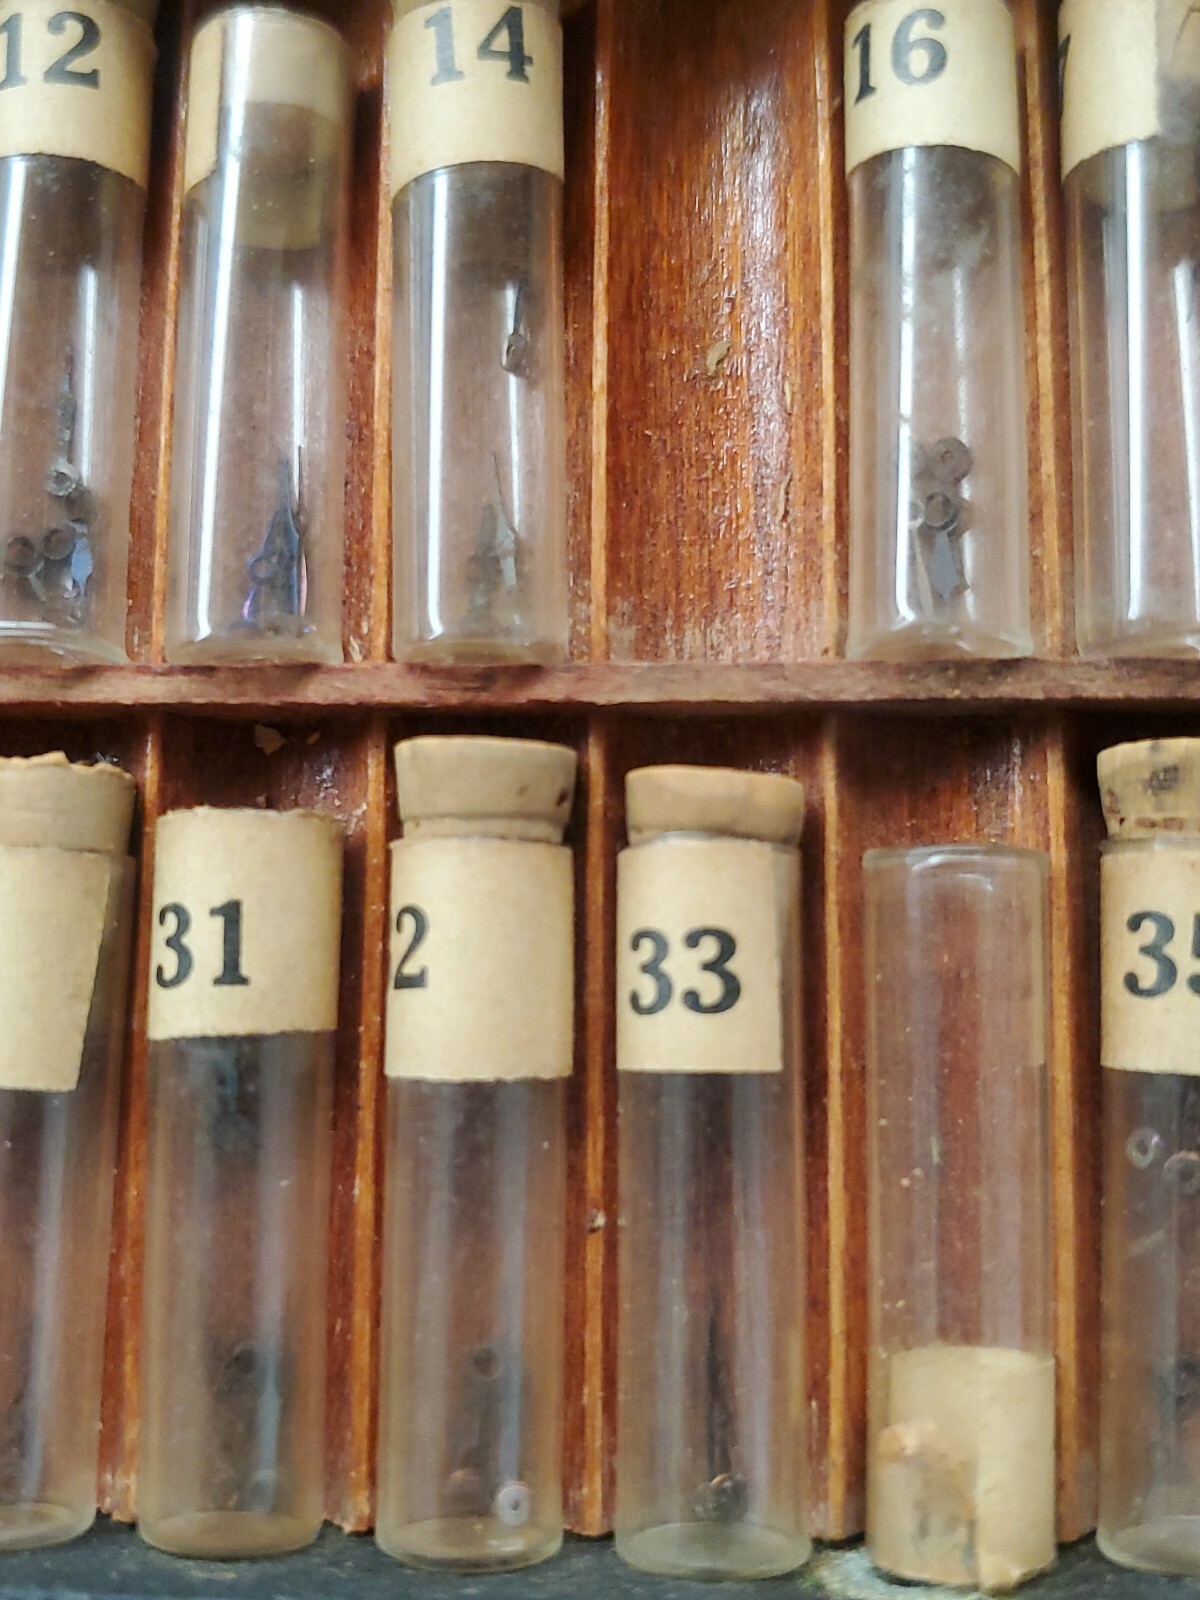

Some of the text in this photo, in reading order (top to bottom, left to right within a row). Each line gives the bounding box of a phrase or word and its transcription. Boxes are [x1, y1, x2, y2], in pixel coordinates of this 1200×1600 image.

[0, 11, 99, 89] 12
[424, 6, 534, 84] 14
[853, 9, 947, 102] 16
[155, 899, 249, 988] 31
[630, 928, 741, 1014] 33
[1123, 910, 1200, 997] 3
